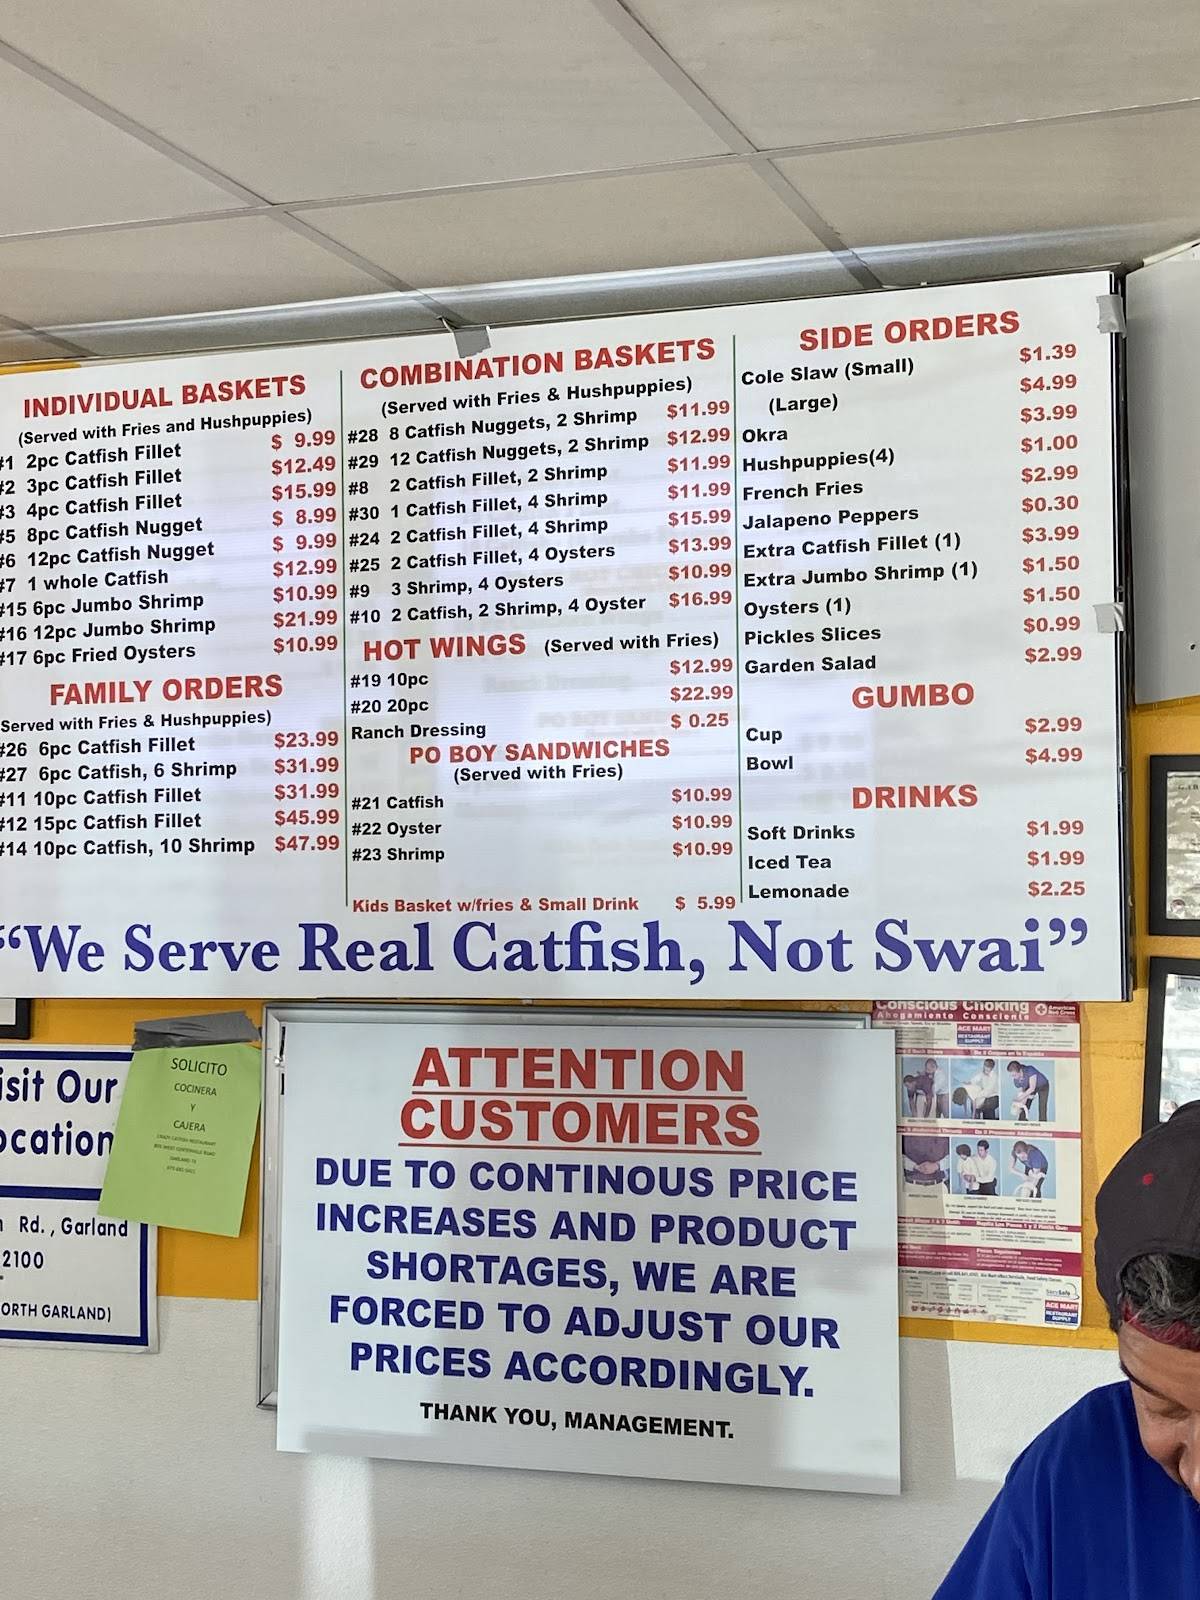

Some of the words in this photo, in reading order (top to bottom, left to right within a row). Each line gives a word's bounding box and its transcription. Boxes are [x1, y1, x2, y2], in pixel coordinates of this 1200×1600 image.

[800, 324, 873, 351] SIDE
[884, 311, 1020, 344] ORDERS
[360, 351, 563, 389] COMBINATION
[575, 338, 715, 371] BASKETS
[1019, 344, 1076, 364] $1.39
[742, 370, 784, 385] Cole
[791, 366, 838, 381] Slaw
[845, 357, 913, 381] (Small)
[1020, 374, 1077, 394] $4.99
[24, 387, 173, 418] INDIVIDUAL
[182, 375, 306, 405] BASKETS
[769, 393, 838, 416] (Large)
[667, 400, 730, 420] $11.99
[1020, 404, 1077, 424] $3.99
[19, 428, 77, 448] (Served
[82, 425, 116, 439] with
[122, 422, 160, 436] Fries
[166, 418, 195, 433] and
[201, 408, 312, 430] Hushpuppies)
[348, 429, 378, 444] #28
[389, 427, 399, 440] 8
[405, 422, 465, 439] Catfish
[472, 416, 550, 435] Nuggets,
[557, 413, 567, 427] 2
[573, 410, 637, 426] Shrimp
[742, 428, 788, 443] Okra
[26, 454, 59, 471] 2pc
[65, 447, 128, 466] Catfish
[135, 443, 181, 460] Fillet
[272, 456, 336, 476] $12.49
[743, 448, 894, 472] Hushpuppies(4)
[743, 483, 808, 501] French
[816, 481, 863, 496] Fries
[668, 509, 731, 528] $15.99
[743, 514, 831, 531] Jalapeno
[839, 509, 919, 526] Peppers
[744, 572, 795, 587] Extra
[802, 568, 867, 584] Jumbo
[874, 565, 944, 581] Shrimp
[952, 561, 977, 580] (1)
[273, 584, 337, 604] $10.99
[349, 584, 370, 598] #9
[391, 582, 401, 596] 3
[407, 580, 472, 595] Shrimp,
[478, 577, 489, 590] 4
[495, 575, 563, 593] Oysters
[273, 610, 337, 629] $21.99
[1024, 616, 1080, 634] $0.99
[33, 650, 65, 668] 6pc
[72, 646, 117, 663] Fried
[124, 645, 195, 664] Oysters
[364, 639, 421, 662] HOT
[429, 633, 526, 658] WINGS
[1025, 646, 1082, 664] $2.99
[670, 658, 733, 675] $12.99
[745, 658, 814, 674] Garden
[822, 655, 876, 671] Salad
[50, 680, 152, 706] FAMILY
[162, 674, 283, 701] ORDERS
[350, 674, 381, 688] #19
[387, 672, 428, 689] 10pc
[670, 685, 733, 703] $22.99
[852, 683, 974, 709] GUMBO
[274, 731, 339, 749] $23.99
[352, 725, 404, 740] Ranch
[410, 722, 486, 739] Dressing
[746, 728, 782, 744] Cup
[410, 746, 441, 764] PO
[450, 745, 497, 763] BOY
[505, 739, 669, 761] SANDWICHES
[39, 766, 71, 784] 6pc
[78, 764, 147, 781] Catfish,
[154, 763, 164, 777] 6
[171, 761, 237, 779] Shrimp
[747, 756, 793, 770] Bowl
[352, 796, 379, 810] #21
[387, 795, 443, 809] Catfish
[853, 784, 978, 809] DRINKS
[747, 826, 786, 840] Soft
[793, 825, 855, 839] Drinks
[1027, 820, 1084, 837] $1.99
[34, 841, 77, 859] 10pc
[84, 839, 153, 857] Catfish,
[160, 838, 182, 853] 10
[188, 837, 255, 856] Shrimp
[275, 835, 339, 853] $47.99
[673, 842, 733, 858] $10.99
[748, 855, 789, 869] Iced
[796, 855, 831, 869] Tea
[749, 884, 849, 899] Lemonade
[1028, 881, 1085, 897] $2.25
[353, 899, 389, 912] Kids
[395, 899, 452, 912] Basket
[457, 898, 513, 912] w/fries
[520, 898, 532, 911] &
[539, 897, 586, 911] Small
[593, 897, 638, 910] Drink
[124, 924, 280, 972] Serve
[298, 921, 434, 972] Real
[453, 920, 704, 986] Catfish,
[728, 920, 854, 972] Not
[877, 1011, 954, 1020] Ahogamiento
[963, 1012, 1029, 1021] Consciente
[170, 1057, 227, 1076] SOLICITO
[412, 1047, 743, 1092] ATTENTION
[57, 1069, 118, 1104] Our
[174, 1083, 217, 1096] COCINERA
[190, 1103, 196, 1112] Y
[173, 1120, 205, 1132] CAJERA
[401, 1099, 760, 1147] CUSTOMERS
[316, 1158, 391, 1187] DUE
[405, 1160, 455, 1189] TO
[470, 1161, 714, 1197] CONTINOUS
[730, 1168, 857, 1202] PRICE
[61, 1217, 128, 1237] Garland
[317, 1203, 537, 1239] INCREASES
[549, 1211, 636, 1242] AND
[651, 1214, 856, 1251] PRODUCT
[367, 1250, 618, 1297] SHORTAGES,
[632, 1261, 696, 1293] WE
[710, 1264, 796, 1297] ARE
[42, 1304, 111, 1323] GARLAND)
[330, 1295, 484, 1330] FORCED
[498, 1302, 550, 1334] TO
[564, 1306, 731, 1343] ADJUST
[746, 1314, 840, 1349] OUR
[351, 1342, 491, 1378] PRICES
[504, 1351, 813, 1397] ACCORDINGLY.
[420, 1402, 497, 1423] THANK
[504, 1407, 556, 1431] YOU,
[565, 1411, 734, 1439] MANAGEMENT.
